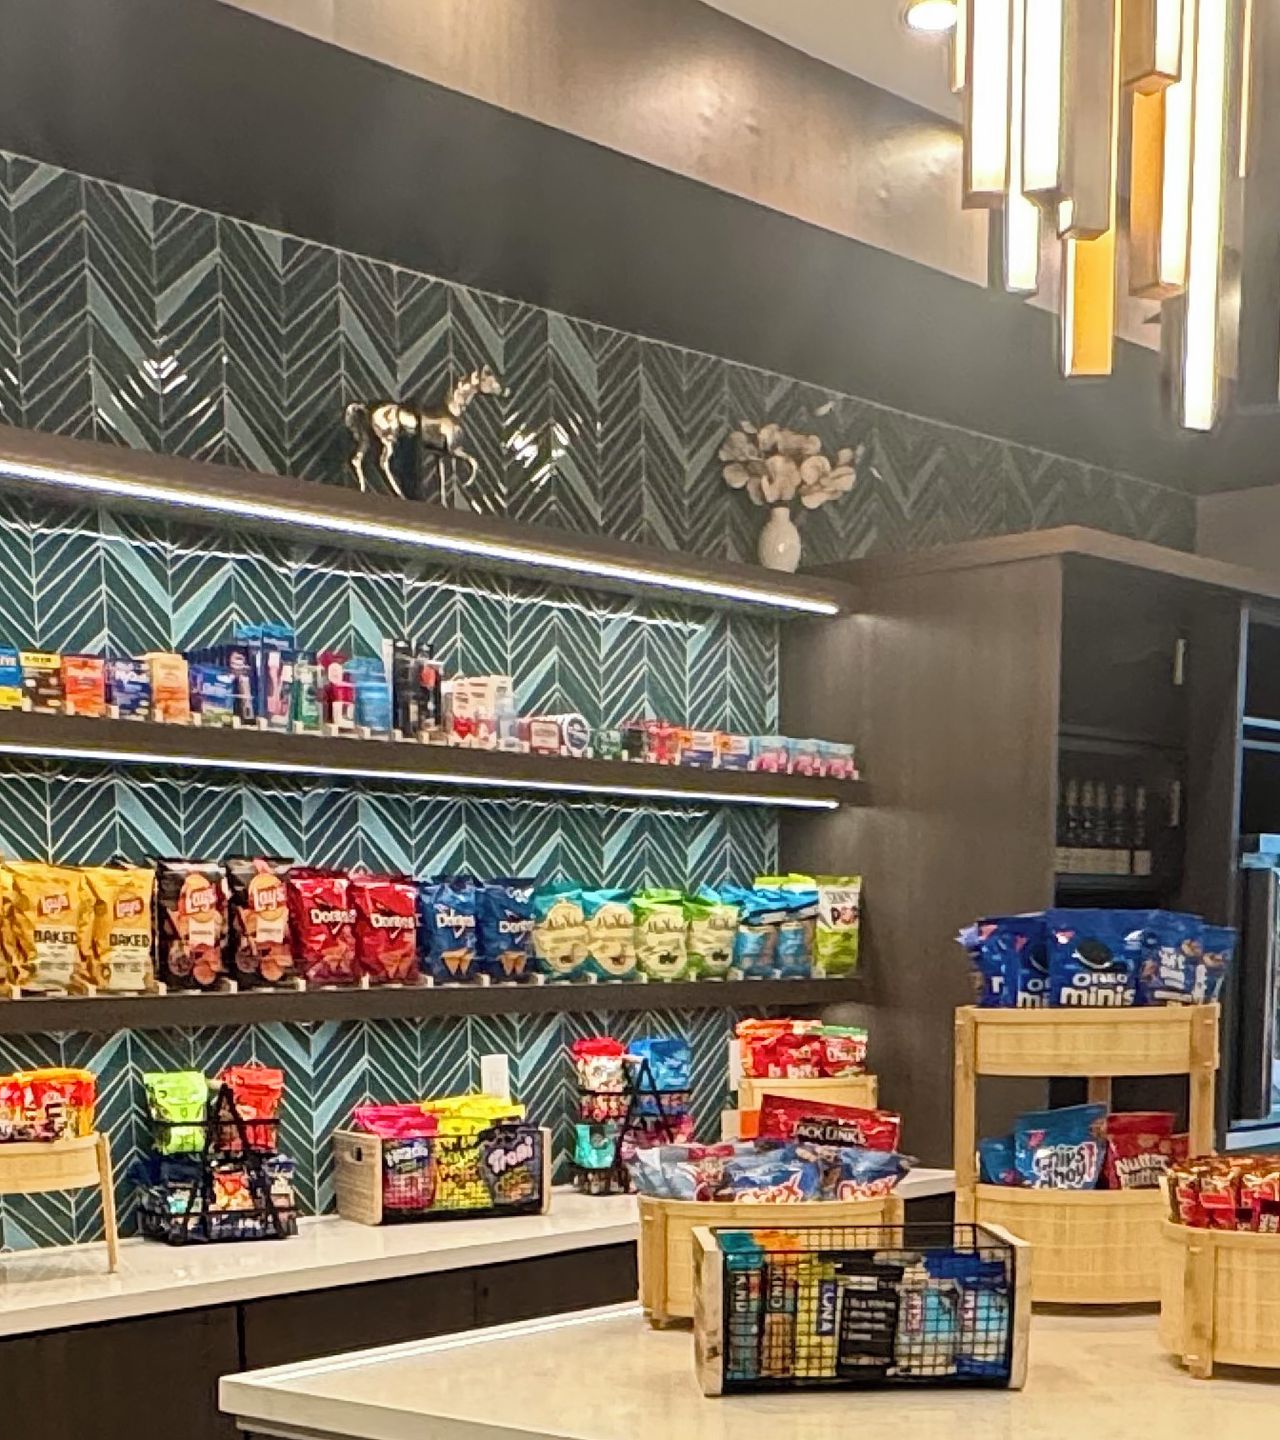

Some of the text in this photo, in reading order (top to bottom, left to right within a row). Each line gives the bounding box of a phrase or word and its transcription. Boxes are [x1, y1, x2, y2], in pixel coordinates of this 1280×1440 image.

[33, 930, 77, 944] BAKED
[109, 934, 150, 948] BAKED
[1060, 986, 1136, 1005] minis
